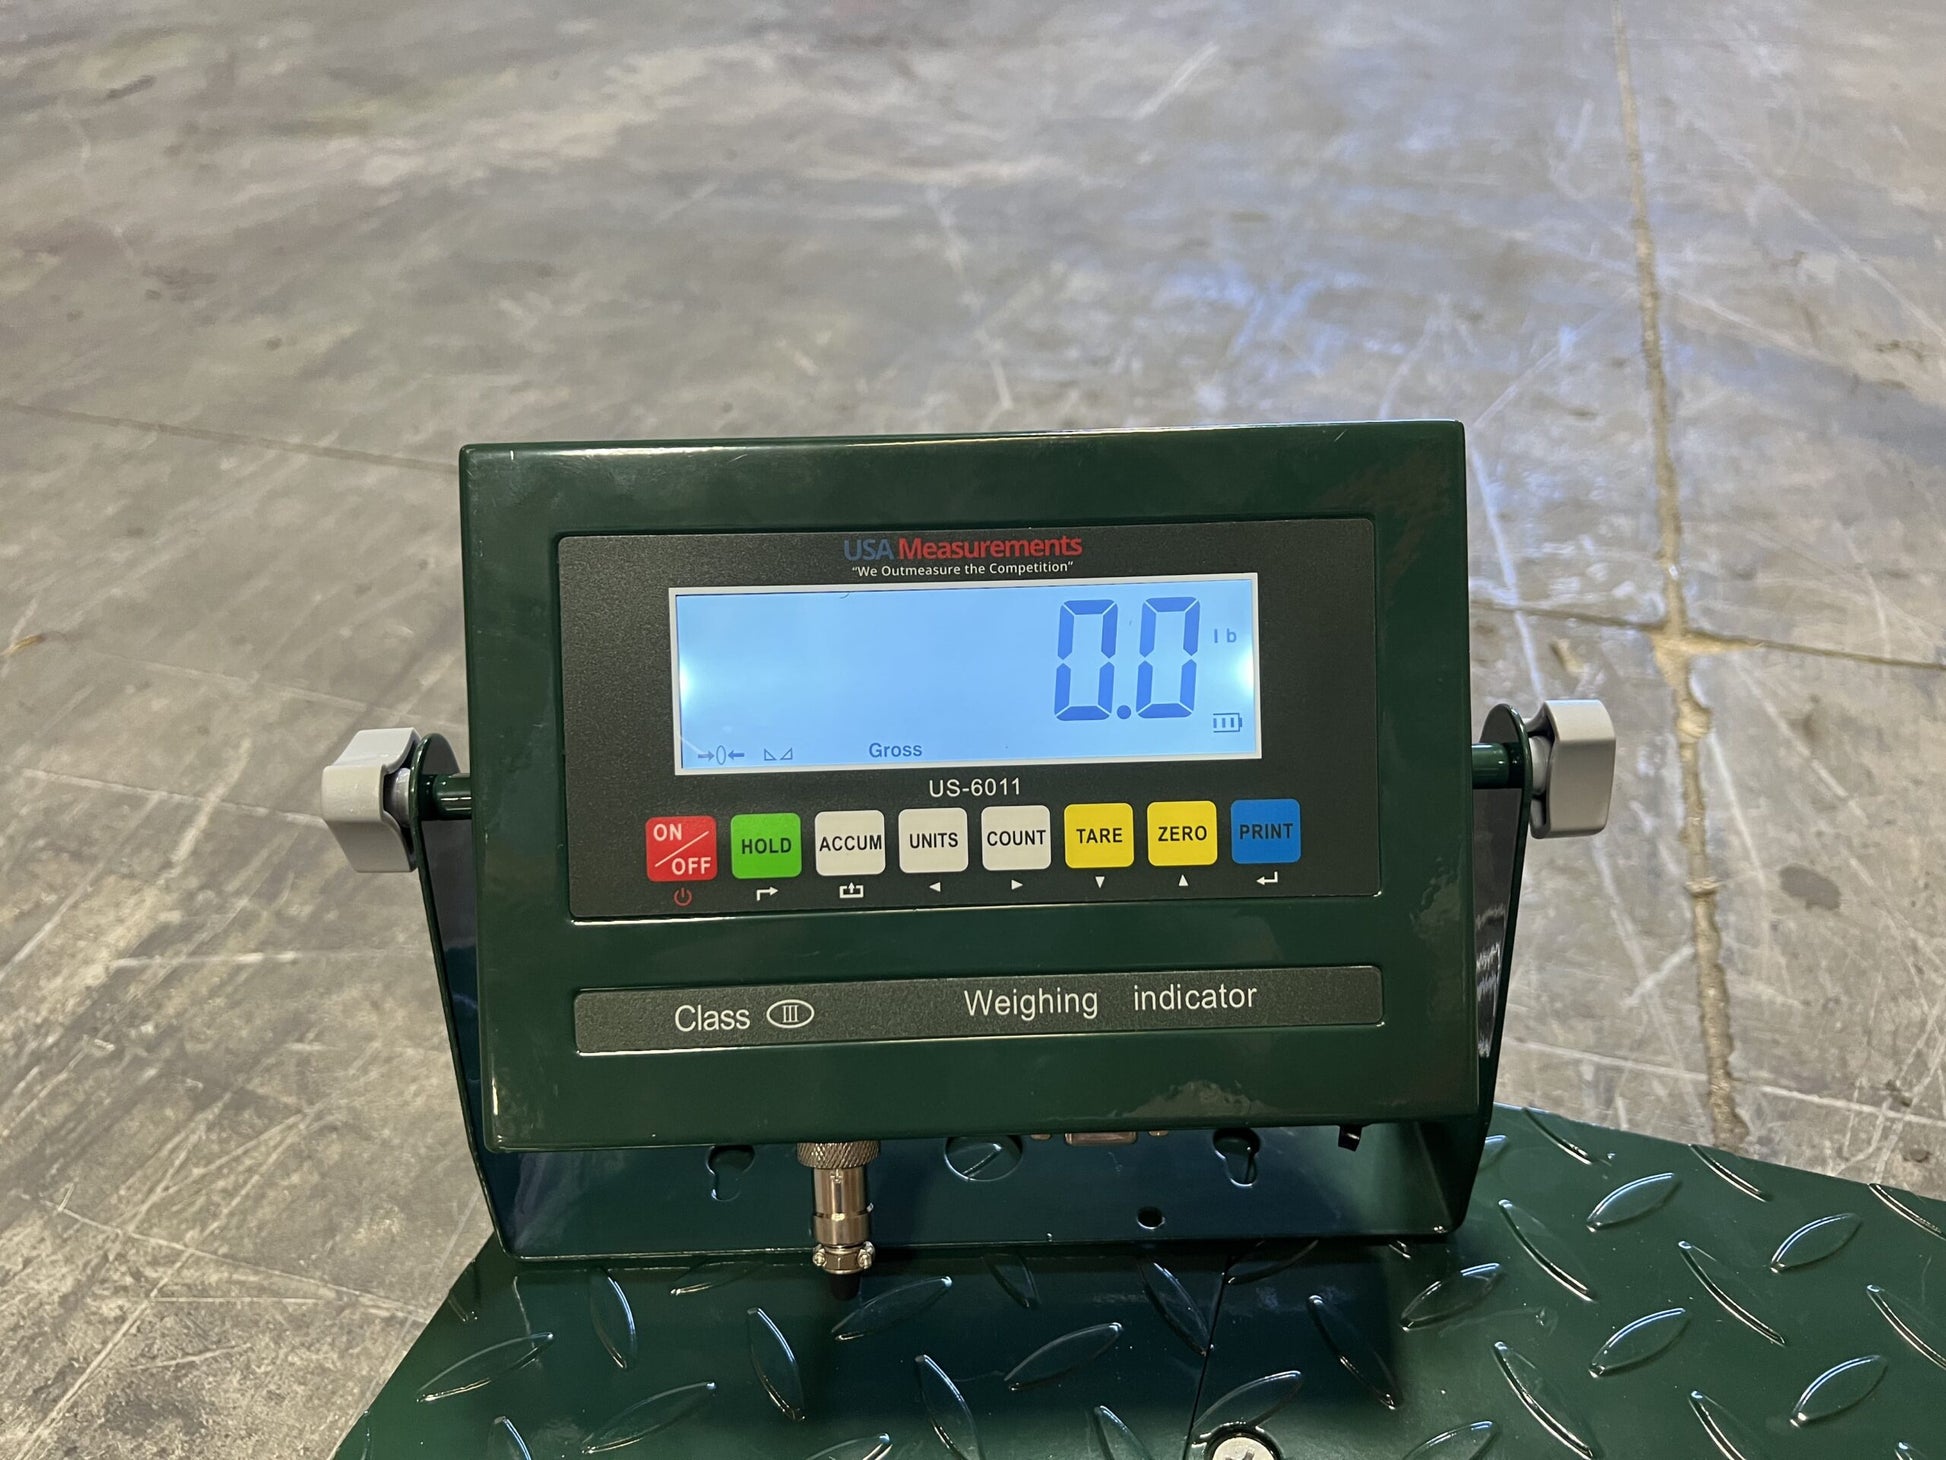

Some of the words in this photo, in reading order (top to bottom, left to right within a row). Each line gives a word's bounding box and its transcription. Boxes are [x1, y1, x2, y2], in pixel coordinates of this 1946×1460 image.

[844, 538, 894, 561] USA
[898, 535, 1083, 560] Measurements
[881, 563, 961, 576] Outmeasure
[964, 562, 986, 574] the
[1054, 596, 1200, 722] 0.0
[868, 741, 923, 760] Gross
[927, 777, 1022, 798] US-6011
[652, 823, 684, 843] ON
[909, 830, 959, 849] UNITS
[987, 828, 1047, 847] COUNT
[1075, 826, 1124, 845] TARE
[1157, 823, 1208, 843] ZERO
[1239, 821, 1293, 841] PRINT
[741, 836, 792, 856] HOLD
[819, 834, 883, 853] ACCUM
[671, 857, 712, 876] OFF
[964, 988, 1099, 1020] Weighing
[1133, 984, 1257, 1012] indicator
[674, 1005, 751, 1032] Class
